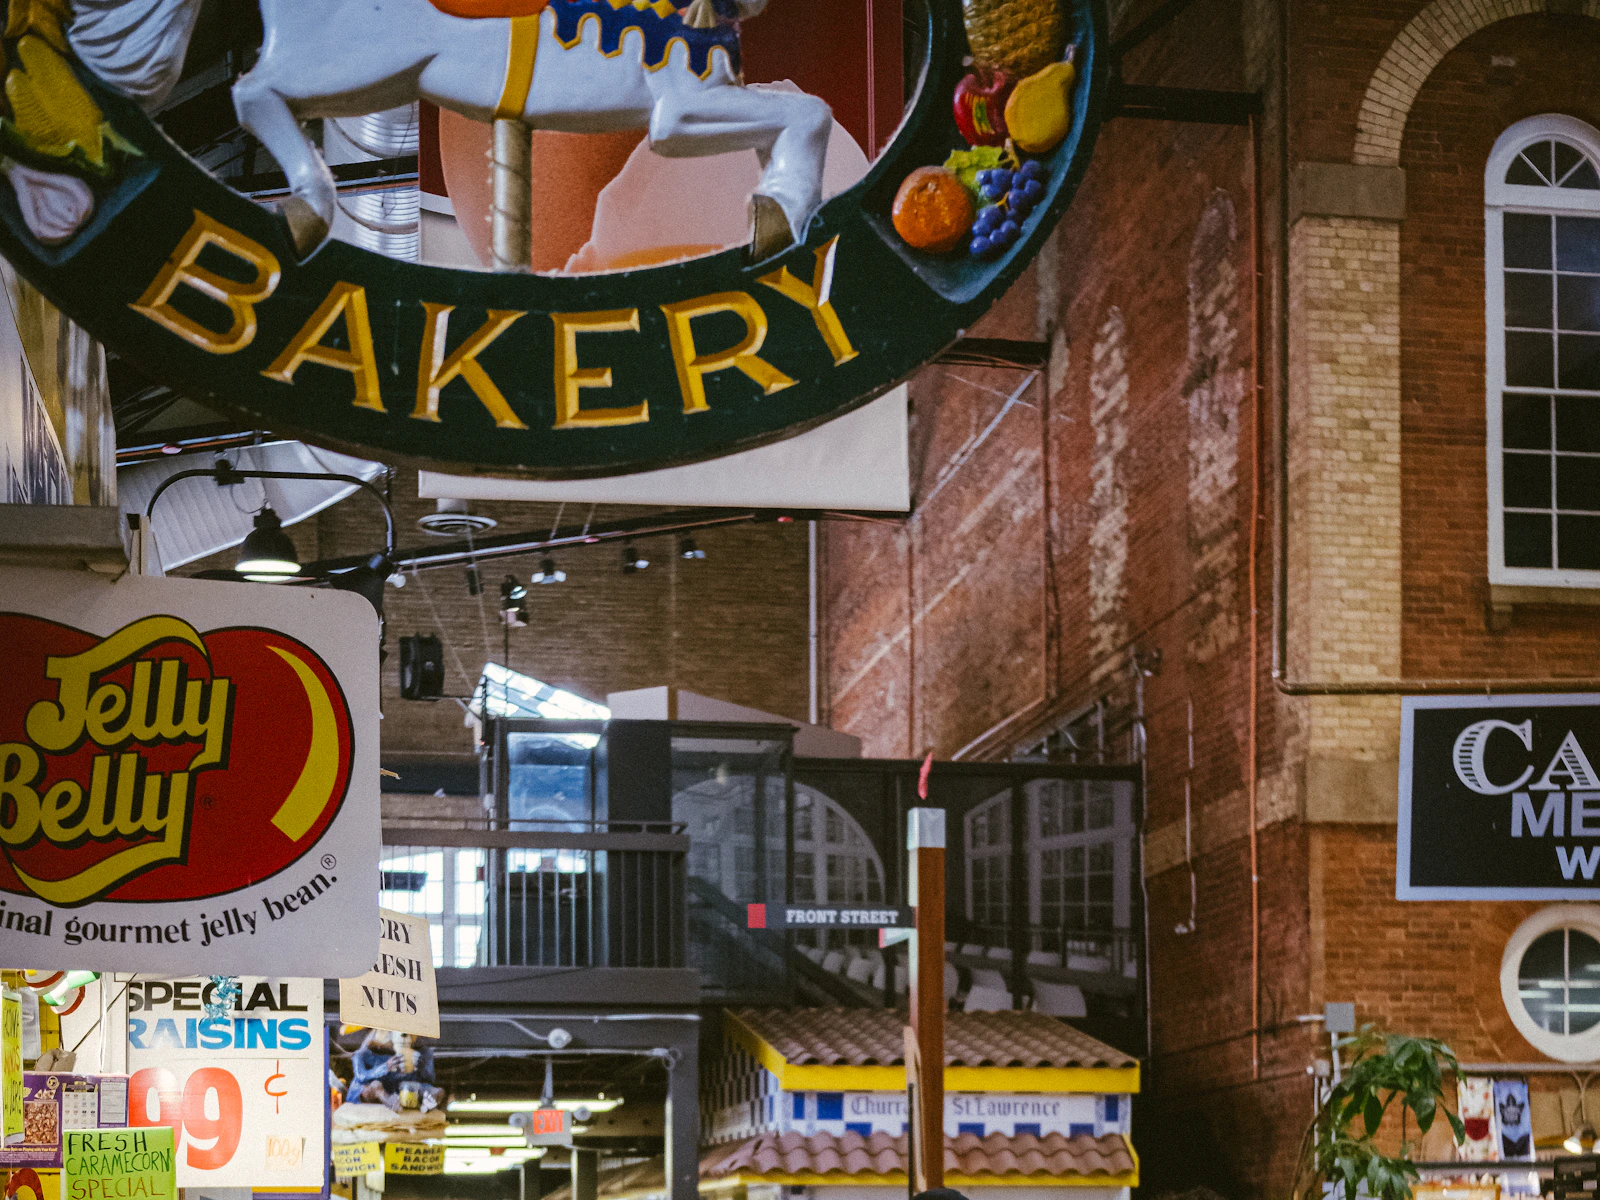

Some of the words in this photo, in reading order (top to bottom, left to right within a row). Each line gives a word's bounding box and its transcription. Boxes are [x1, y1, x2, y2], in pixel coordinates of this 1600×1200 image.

[128, 208, 859, 431] BAKERY
[25, 616, 232, 772] Jelly
[1453, 719, 1600, 795] CA
[0, 742, 191, 905] Belly
[1511, 792, 1600, 837] ME
[64, 915, 191, 946] gourmet
[200, 907, 257, 946] jelly
[262, 873, 337, 921] bean.
[786, 909, 837, 923] FRONT
[841, 909, 898, 924] STREET
[128, 981, 309, 1012] SPECIAL
[361, 984, 418, 1016] NUTS
[128, 1017, 311, 1051] RAISINS
[68, 1131, 148, 1156] FRESH
[66, 1148, 171, 1176] CARAMECORN
[71, 1176, 166, 1200] SPECIAL
